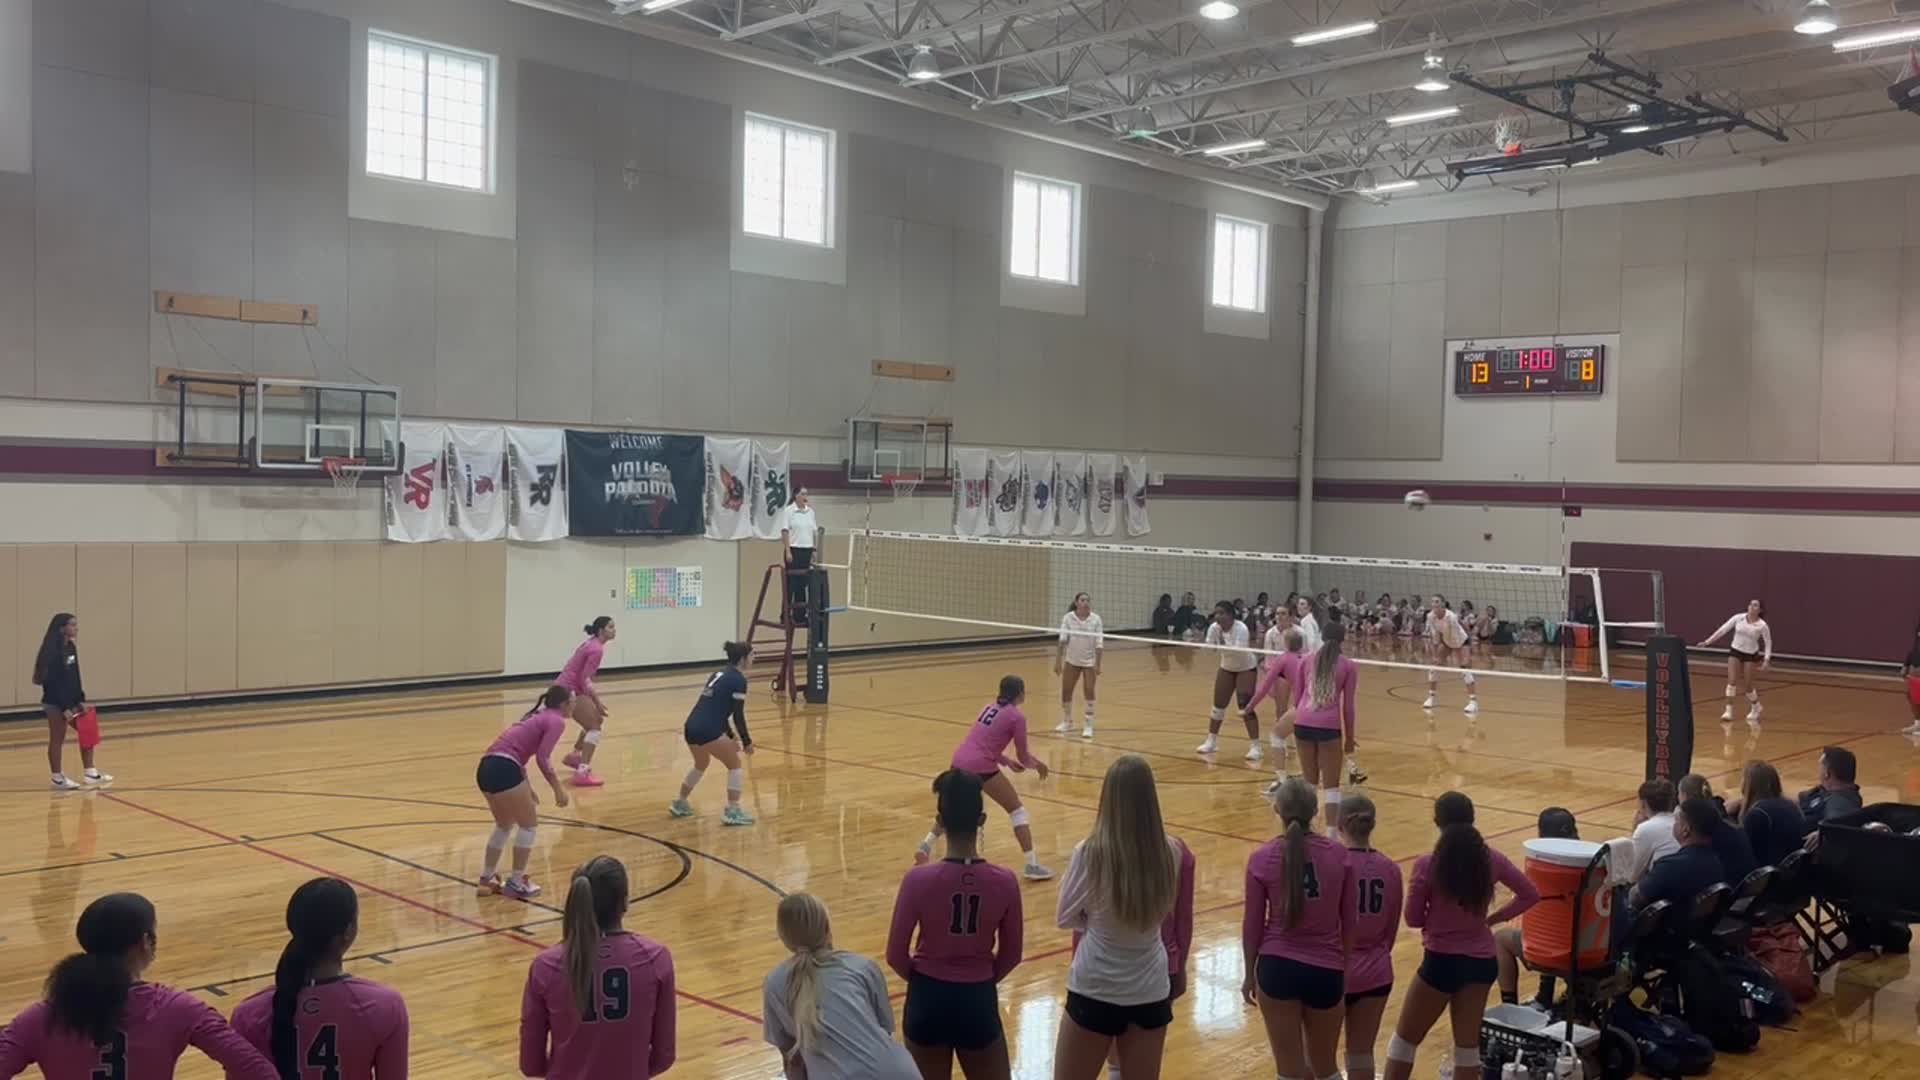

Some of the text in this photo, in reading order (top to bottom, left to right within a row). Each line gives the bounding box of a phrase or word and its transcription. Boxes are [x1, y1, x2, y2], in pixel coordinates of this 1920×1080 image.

[1464, 352, 1487, 362] HOME
[1566, 348, 1594, 359] VISITOR
[1472, 359, 1594, 383] 13 8
[608, 434, 665, 449] WELCOME
[403, 457, 437, 511] VR
[529, 463, 558, 507] RR
[978, 706, 999, 726] 12
[1655, 652, 1670, 781] VOLLEYBA
[950, 892, 981, 936] 11
[1357, 877, 1386, 915] 16
